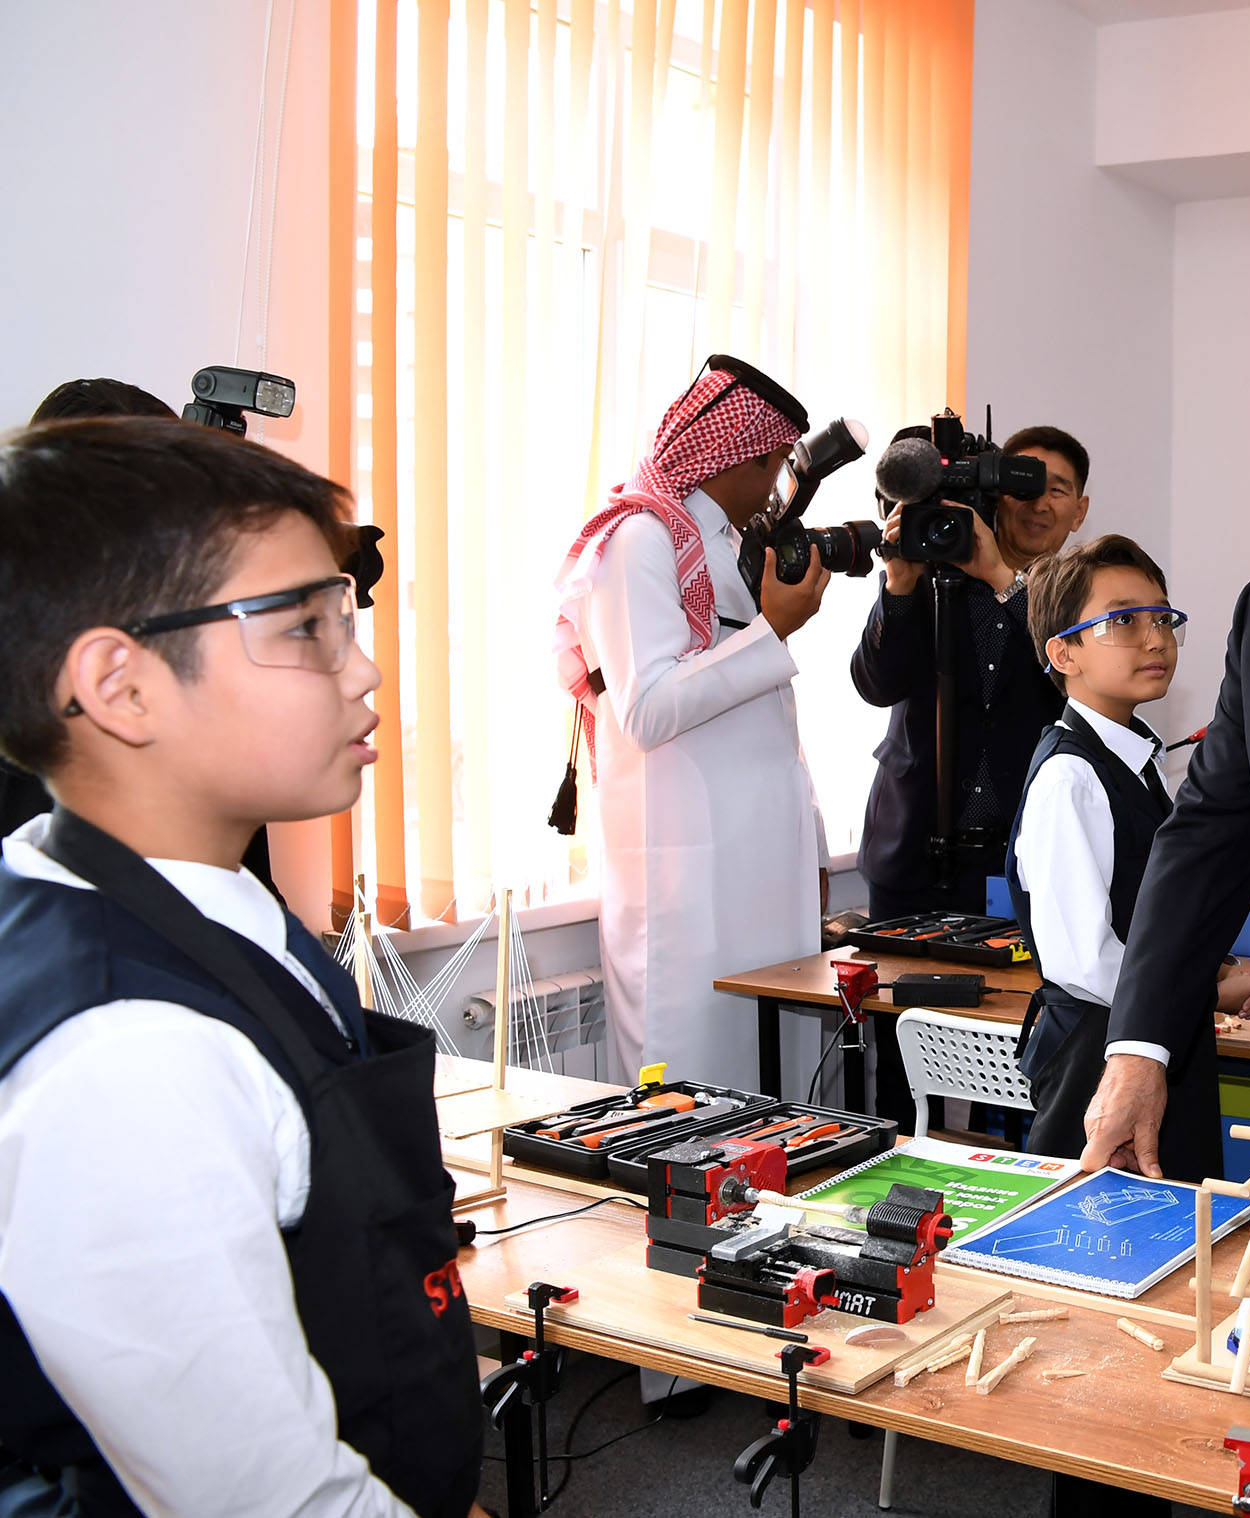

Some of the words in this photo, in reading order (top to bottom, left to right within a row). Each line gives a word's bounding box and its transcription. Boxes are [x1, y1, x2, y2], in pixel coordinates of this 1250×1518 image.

[970, 1153, 1062, 1171] STEM
[944, 1181, 1019, 1197] Издание
[943, 1198, 996, 1211] неров
[955, 1192, 1008, 1204] юных
